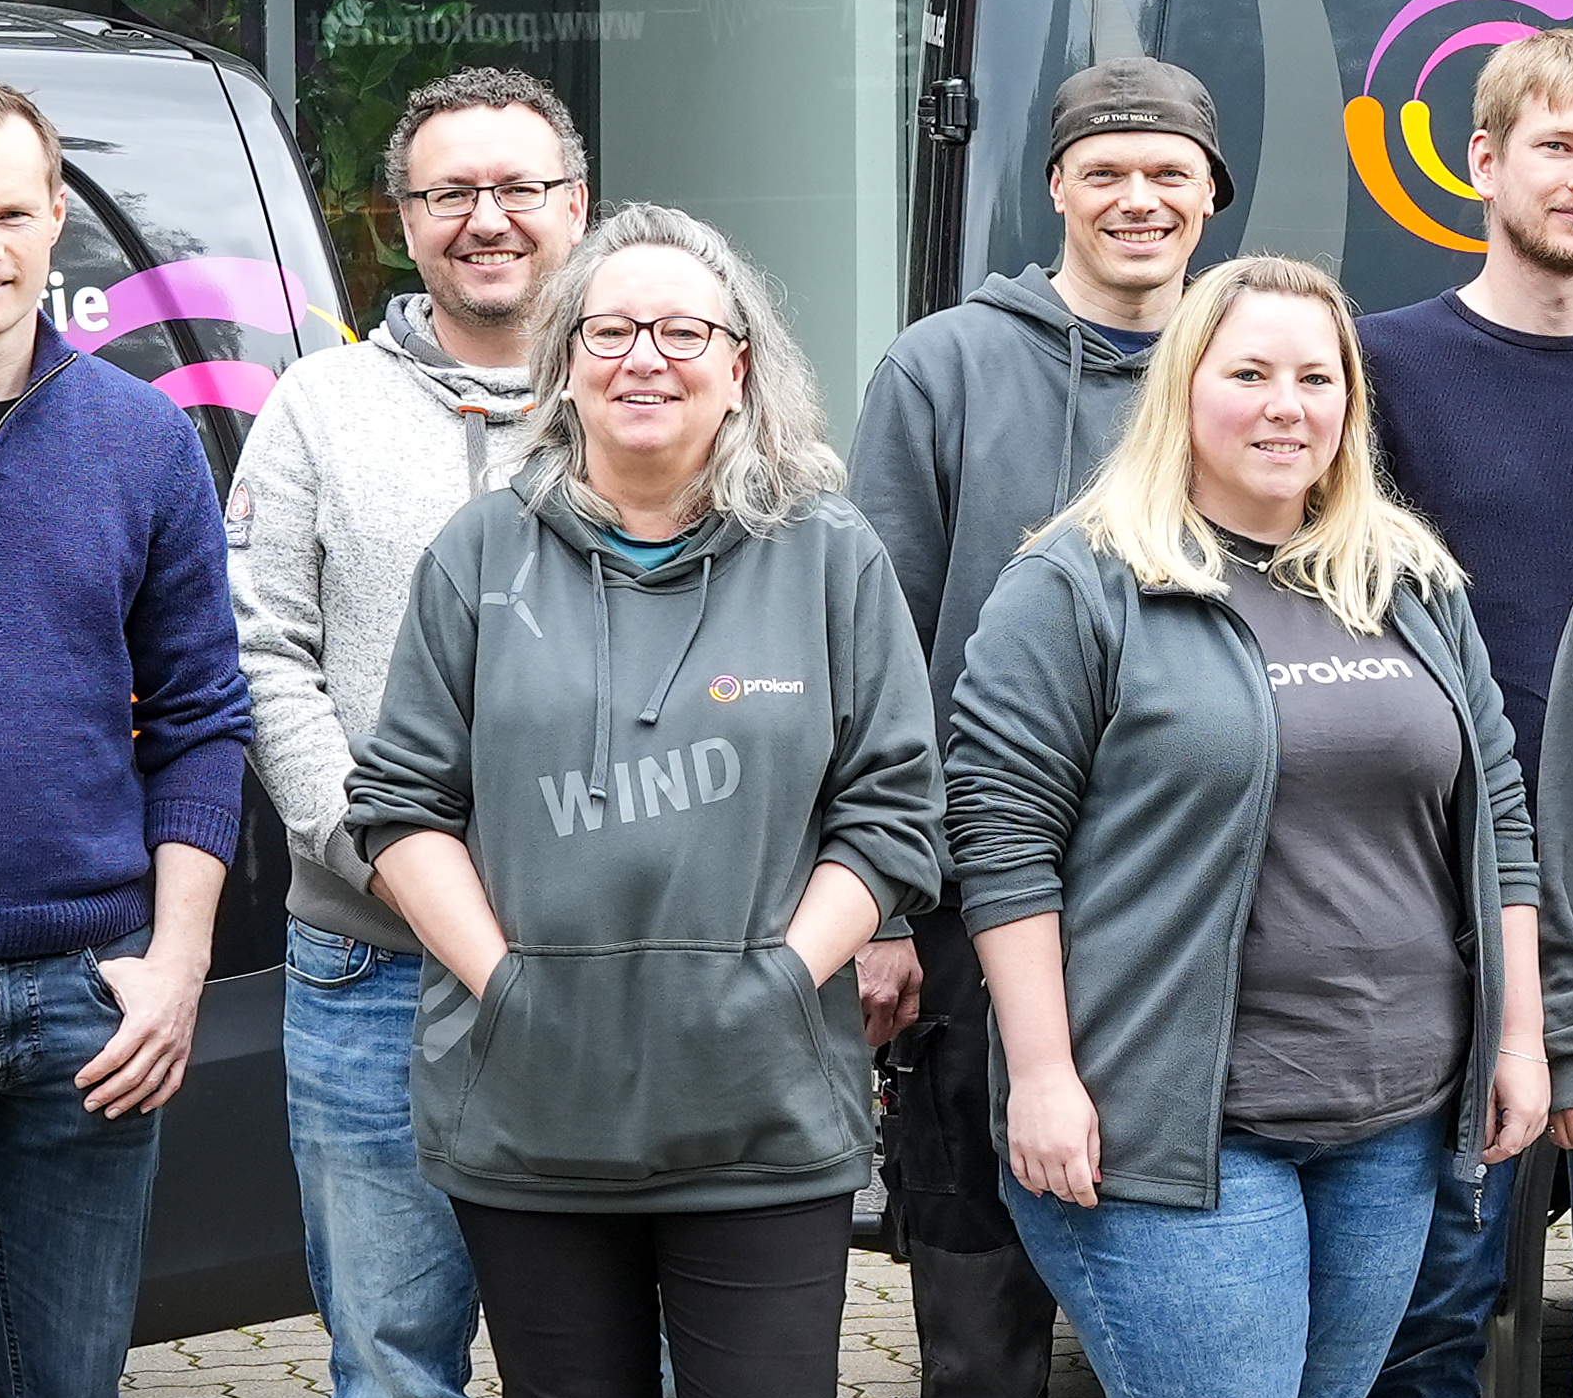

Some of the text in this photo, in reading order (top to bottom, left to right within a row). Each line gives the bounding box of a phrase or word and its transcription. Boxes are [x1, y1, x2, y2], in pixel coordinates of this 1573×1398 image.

[742, 678, 804, 696] prokon
[1265, 655, 1414, 693] prokon
[537, 736, 743, 838] WIND
